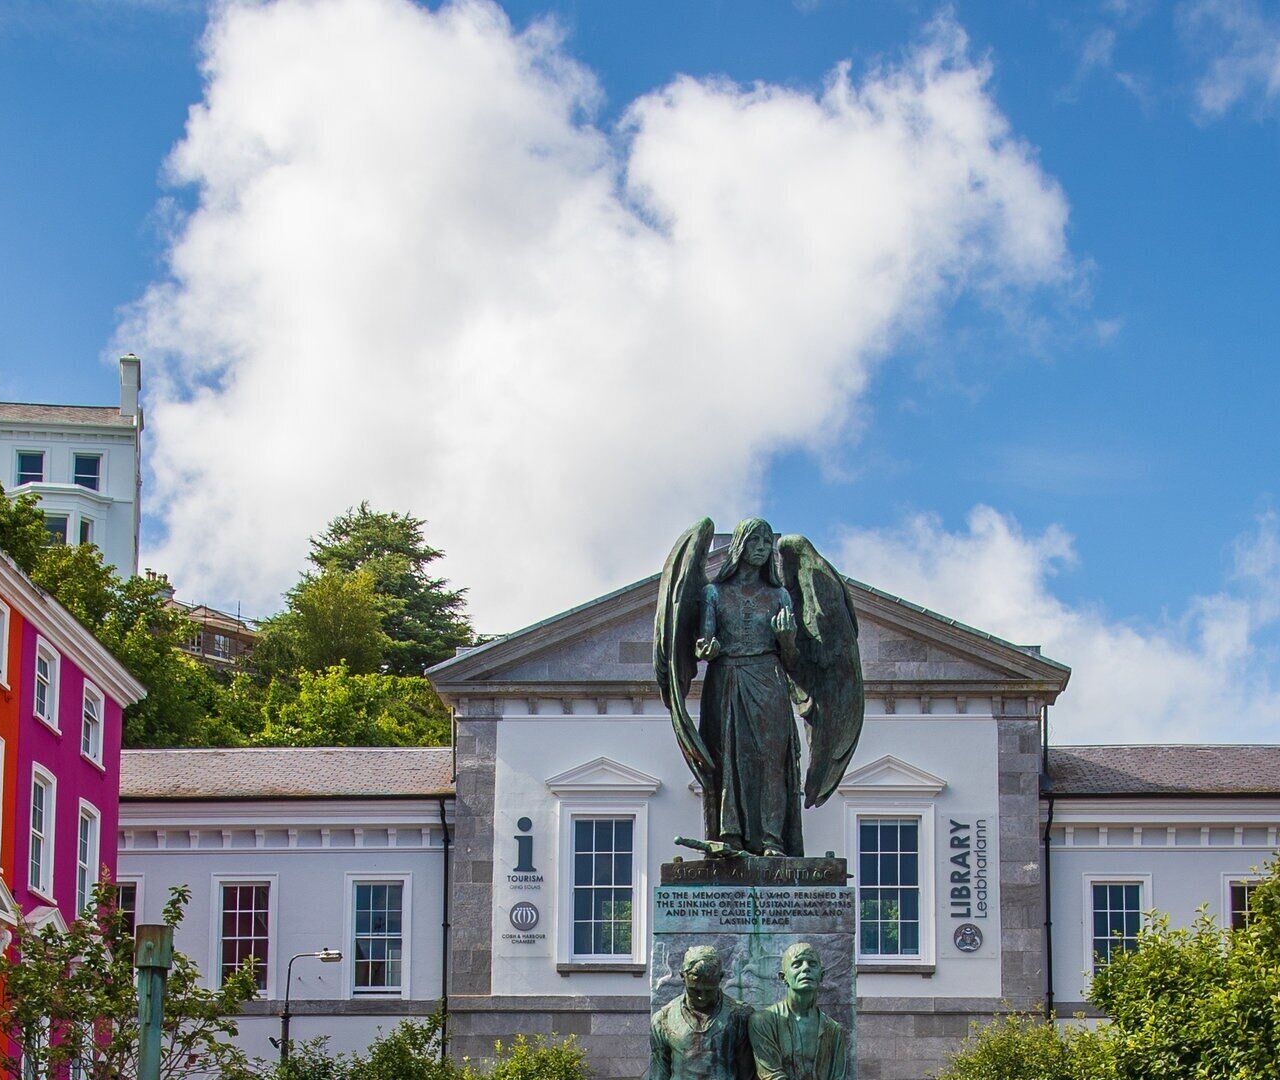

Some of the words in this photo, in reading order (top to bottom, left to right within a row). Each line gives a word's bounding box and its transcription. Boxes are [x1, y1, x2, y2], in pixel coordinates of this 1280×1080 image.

[950, 819, 971, 918] LIBRARY
[974, 819, 987, 918] Leabharlann
[507, 875, 544, 883] TOURISM
[657, 891, 670, 900] TO
[672, 891, 688, 900] THE
[692, 891, 733, 900] MEMORY
[734, 891, 745, 900] OF
[747, 891, 763, 900] ALL
[766, 891, 791, 900] WHO
[794, 891, 836, 900] PERISHED
[838, 891, 851, 900] BY
[657, 900, 675, 909] THE
[677, 900, 716, 909] SINKING
[718, 900, 731, 909] OF
[734, 900, 751, 909] THE
[755, 900, 800, 909] LUSITANIA
[803, 900, 823, 909] MAY
[666, 909, 686, 917] AND
[688, 909, 699, 917] IN
[701, 909, 719, 917] THE
[721, 909, 752, 917] CAUSE
[755, 909, 767, 917] OF
[768, 909, 819, 917] UNIVERSAL
[822, 909, 843, 917] AND
